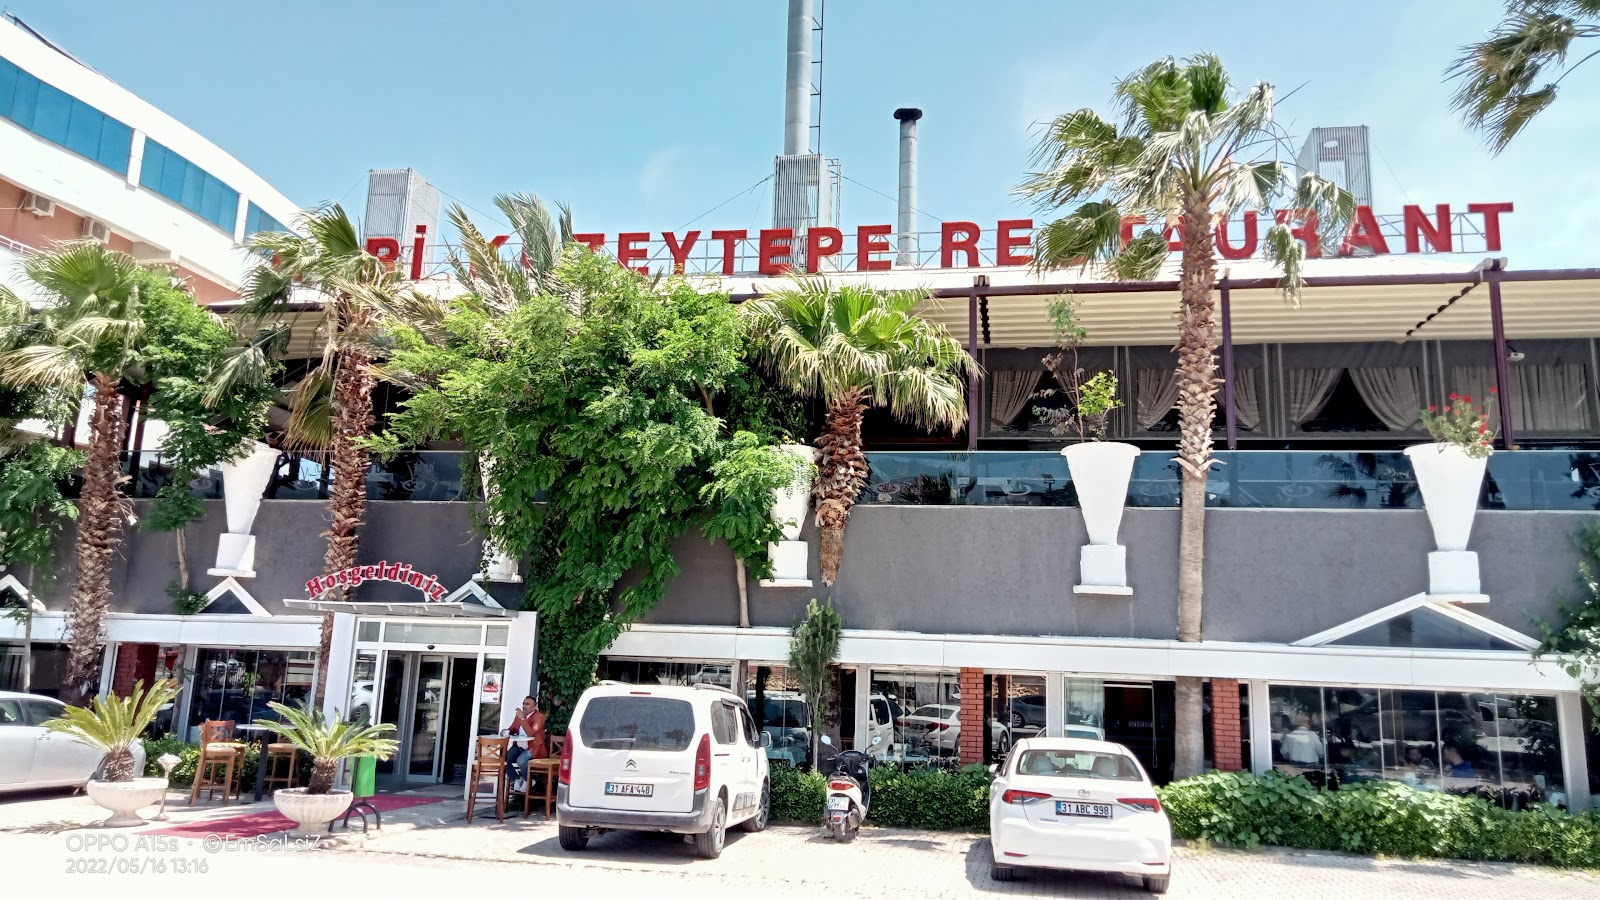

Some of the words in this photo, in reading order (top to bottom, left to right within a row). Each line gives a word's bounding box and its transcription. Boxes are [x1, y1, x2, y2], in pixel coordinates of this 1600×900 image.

[941, 201, 1514, 268] RETAURANT
[305, 560, 449, 601] Hoşgeldiniz
[610, 784, 619, 793] 31
[621, 785, 634, 793] AFA
[1062, 803, 1072, 813] 31
[1075, 804, 1091, 814] ABC
[1093, 805, 1109, 815] 998
